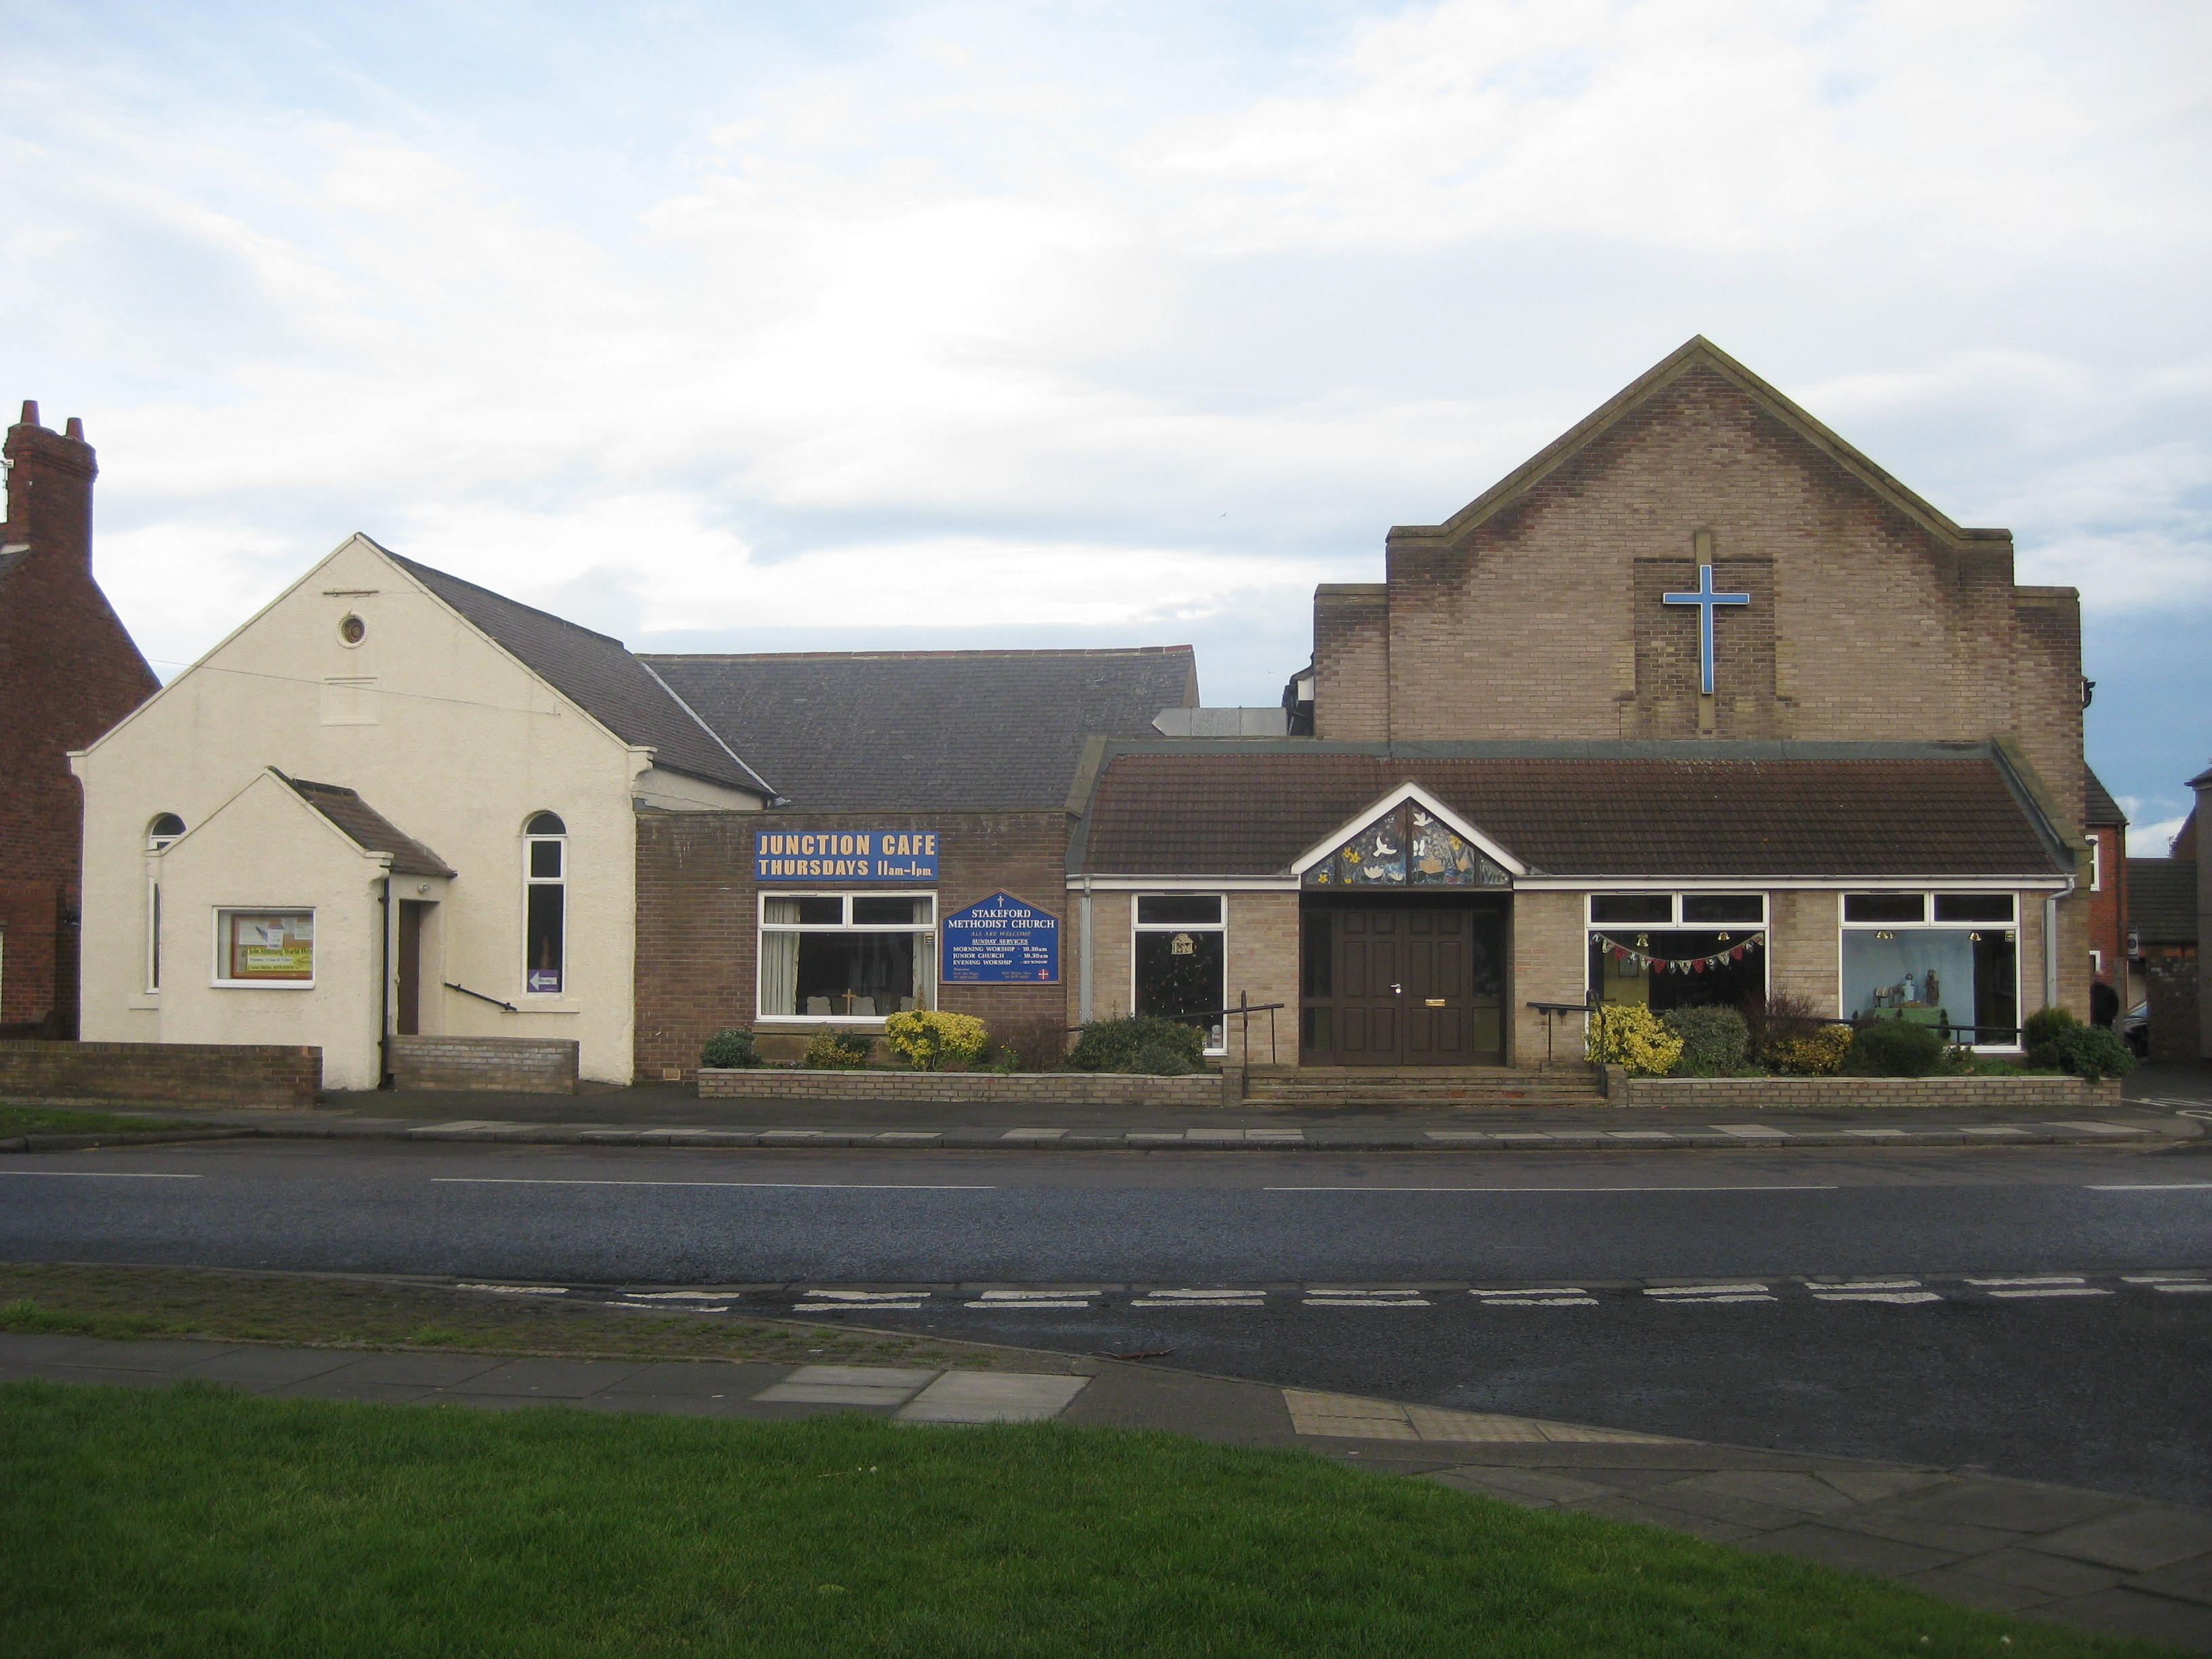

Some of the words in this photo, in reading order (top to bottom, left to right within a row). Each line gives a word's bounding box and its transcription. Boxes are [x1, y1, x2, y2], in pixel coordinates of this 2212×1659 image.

[759, 834, 870, 855] JUNCTION
[882, 834, 935, 855] CAFE
[758, 859, 869, 876] THURSDAYS
[971, 909, 1031, 918] STAKEFORD
[948, 919, 1008, 928] METHODIST
[1011, 919, 1054, 928] CHURCH
